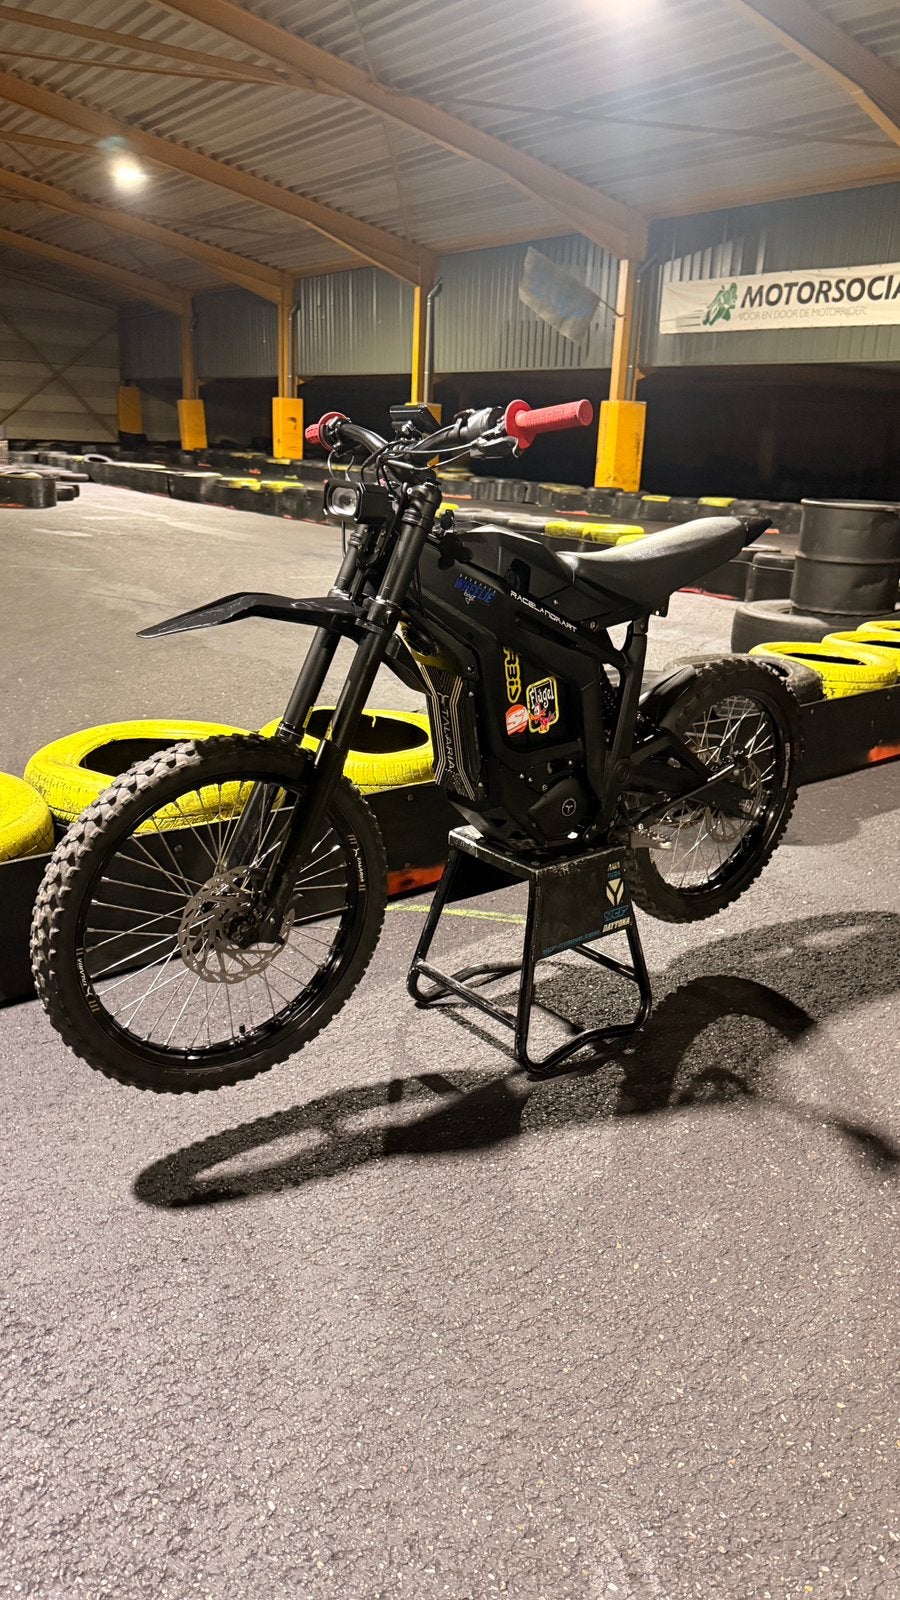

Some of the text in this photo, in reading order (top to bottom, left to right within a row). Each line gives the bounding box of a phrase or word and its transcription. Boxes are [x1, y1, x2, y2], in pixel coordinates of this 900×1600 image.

[739, 311, 761, 321] VOOR
[761, 310, 773, 320] EN
[773, 309, 798, 319] DOOR
[799, 308, 811, 318] DE
[441, 708, 456, 770] TALARIA
